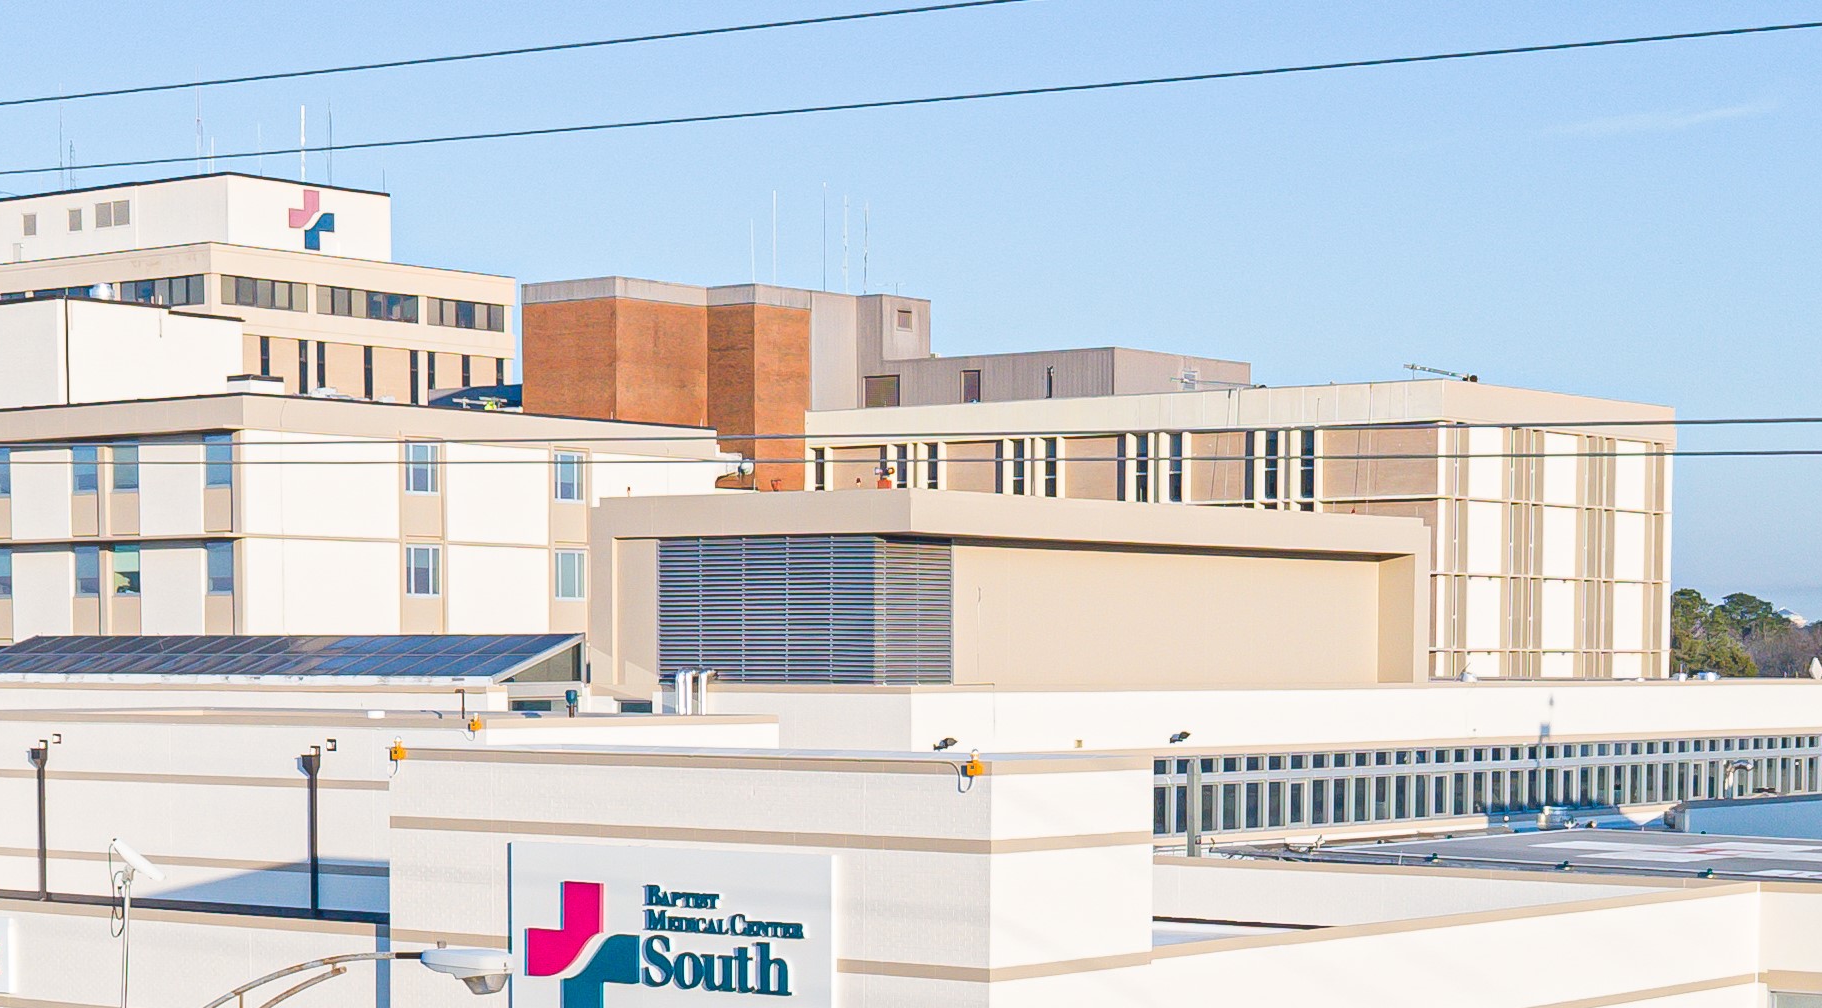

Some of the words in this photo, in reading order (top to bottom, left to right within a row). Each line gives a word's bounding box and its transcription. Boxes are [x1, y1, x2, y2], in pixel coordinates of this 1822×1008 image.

[642, 884, 720, 909] BAPTIST
[643, 909, 729, 935] MEDICAL
[729, 914, 805, 939] CENTER
[641, 934, 792, 996] South
